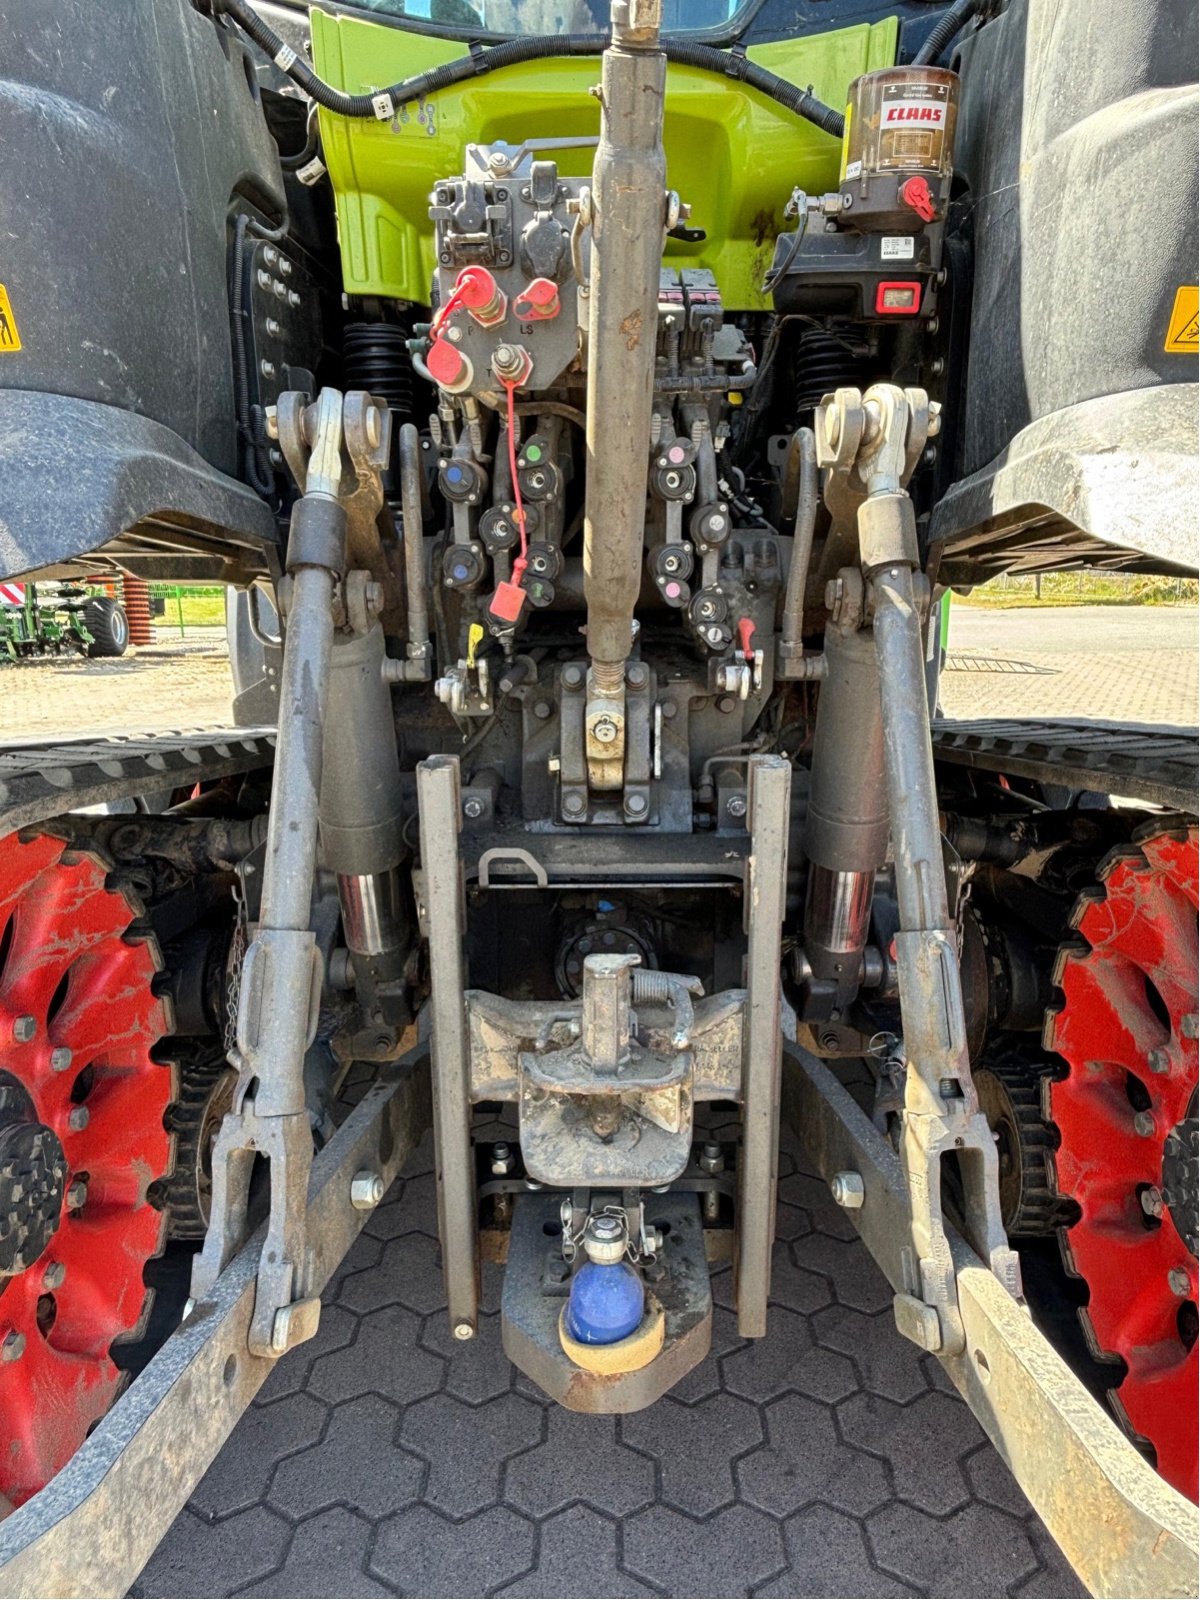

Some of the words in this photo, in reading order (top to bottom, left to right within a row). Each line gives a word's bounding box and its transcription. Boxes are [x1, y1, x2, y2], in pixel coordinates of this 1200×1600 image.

[886, 107, 942, 122] CLAAS
[468, 326, 474, 335] P
[520, 325, 534, 334] LS
[486, 369, 492, 377] T
